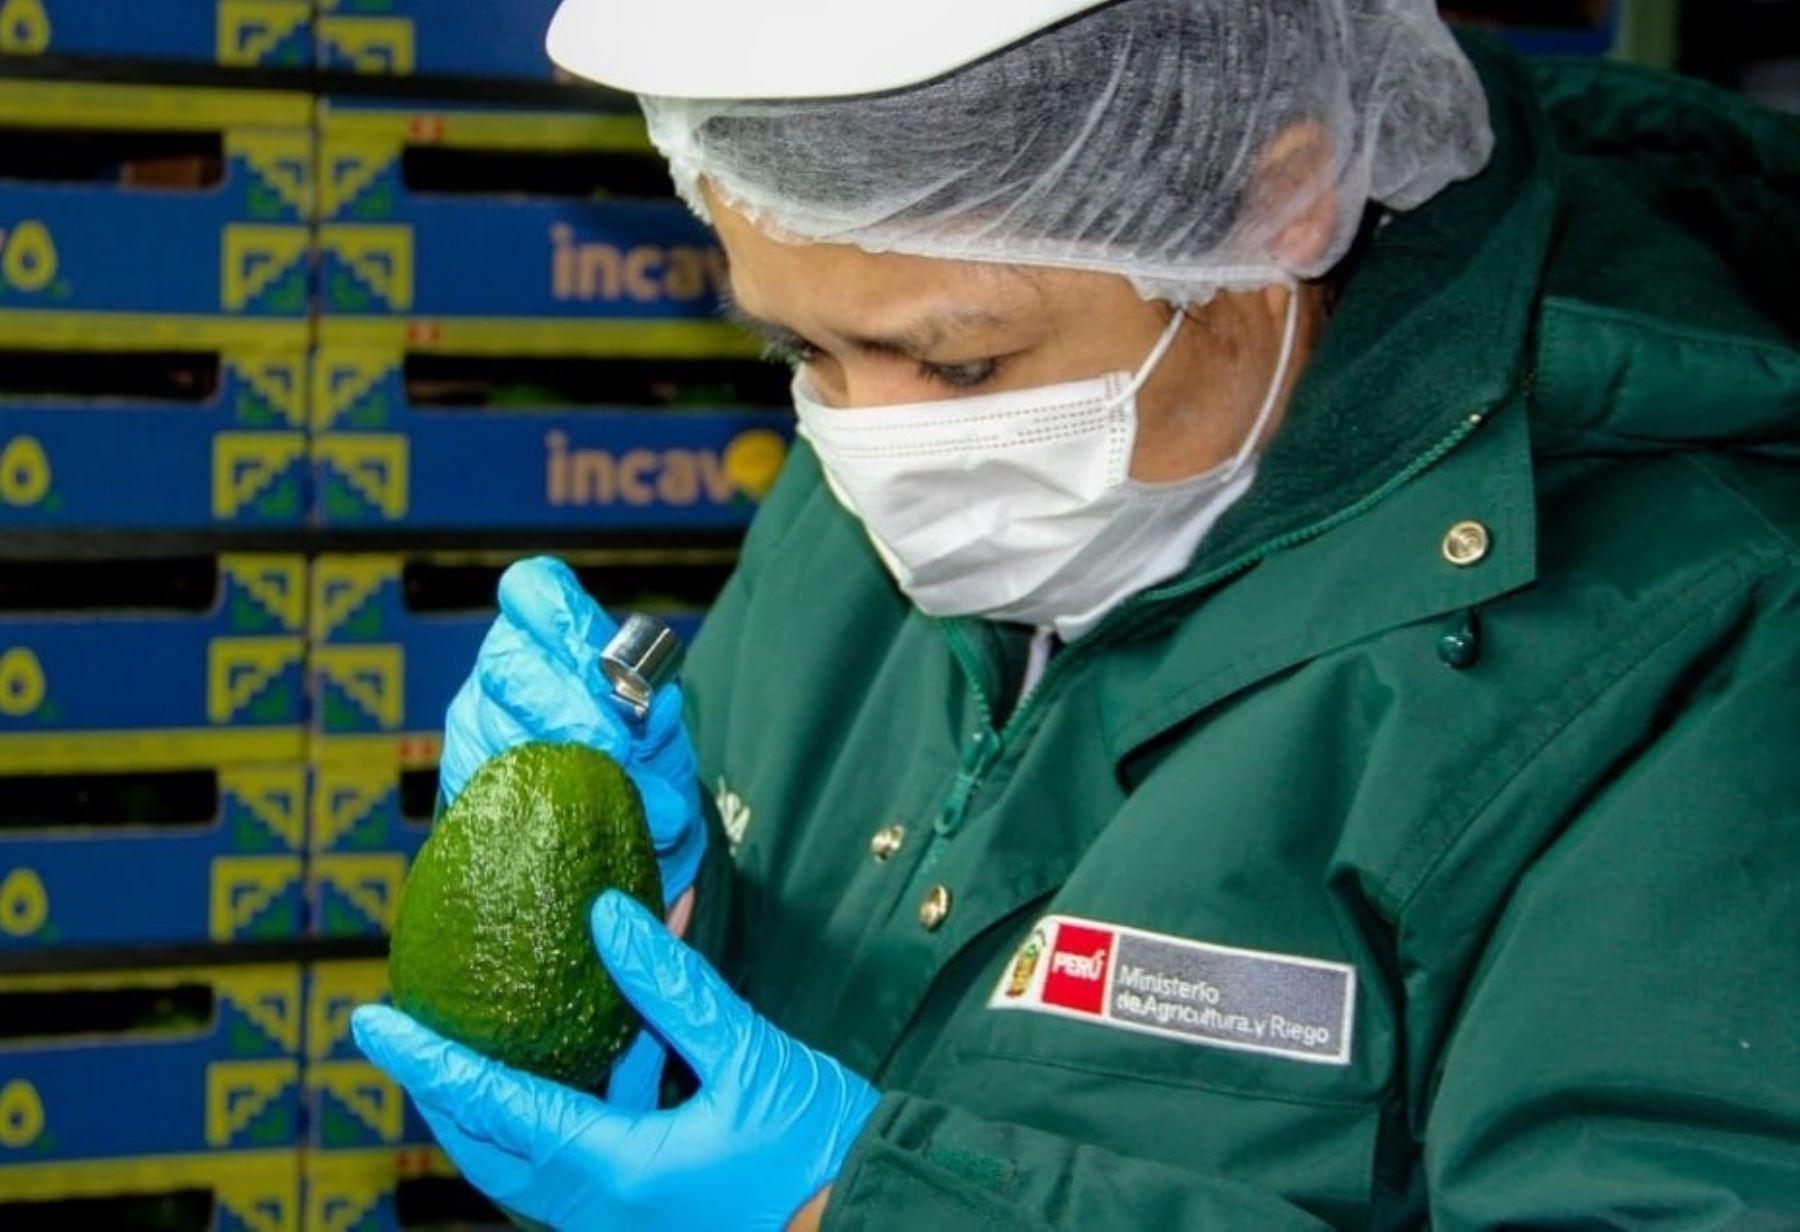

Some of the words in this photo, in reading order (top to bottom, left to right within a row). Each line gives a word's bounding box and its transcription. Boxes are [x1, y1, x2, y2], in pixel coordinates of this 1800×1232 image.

[1053, 950, 1105, 981] PERÚ
[1118, 964, 1220, 1005] Ministerio
[1271, 1015, 1329, 1045] Riego
